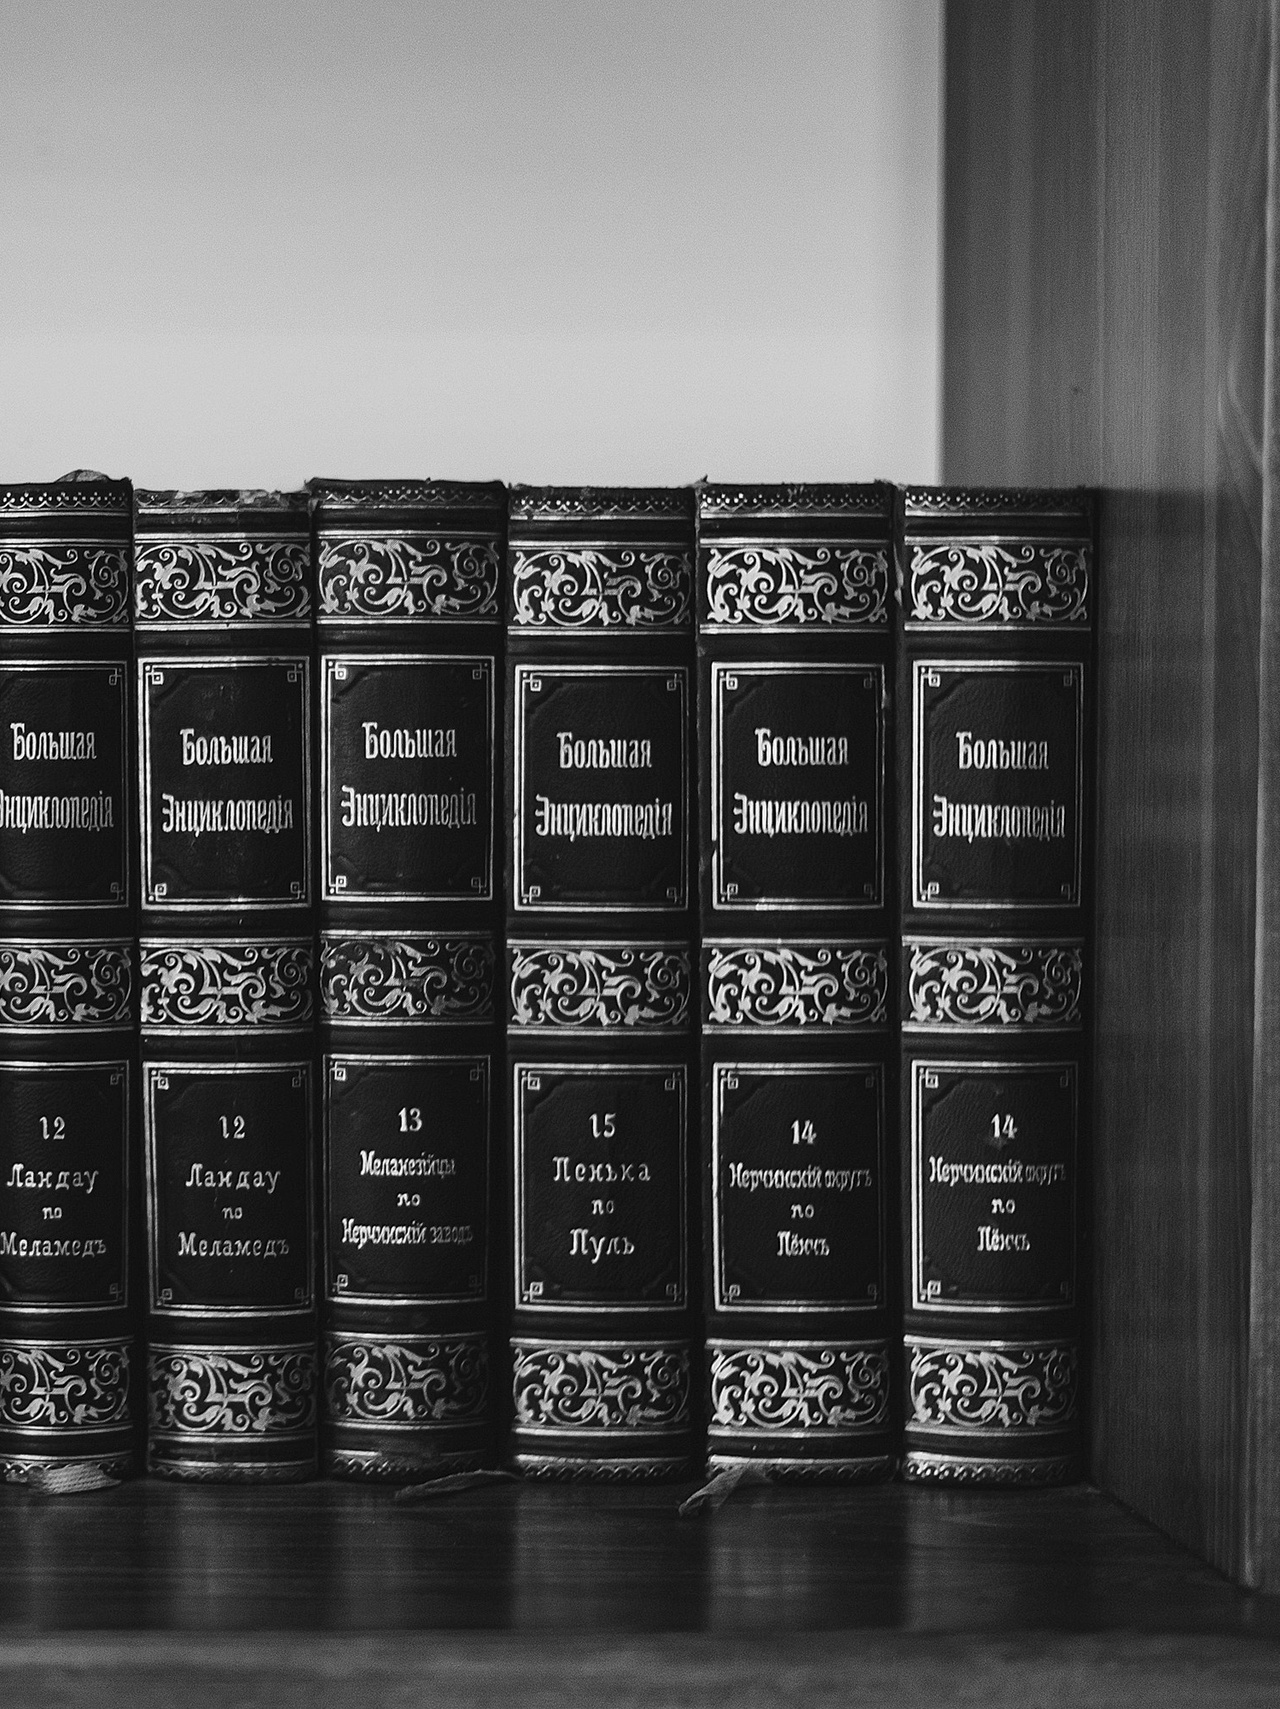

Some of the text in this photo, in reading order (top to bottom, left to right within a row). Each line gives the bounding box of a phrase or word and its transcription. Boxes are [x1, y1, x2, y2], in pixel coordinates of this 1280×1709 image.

[10, 723, 96, 760] Большая
[180, 728, 273, 765] Большая
[362, 722, 456, 759] Большая
[557, 732, 652, 768] Большая
[755, 728, 847, 766] Большая
[956, 732, 1048, 769] Большая
[162, 793, 292, 837] Энциклопедія
[341, 785, 477, 832] Энциклопедія
[535, 794, 672, 842] Энциклопедія
[733, 792, 867, 837] Энциклопедія
[933, 794, 1064, 843] Энциклопедія
[40, 1117, 65, 1139] 12
[220, 1116, 245, 1139] 12
[399, 1108, 422, 1132] 13
[590, 1114, 615, 1138] 15
[792, 1120, 816, 1144] 14
[992, 1114, 1017, 1138] 14
[7, 1163, 98, 1193] Ландау
[186, 1163, 280, 1193] Ландау
[553, 1157, 650, 1182] Пенька
[397, 1193, 420, 1206] по
[592, 1200, 613, 1214] по
[791, 1204, 814, 1218] по
[992, 1199, 1015, 1213] по
[42, 1207, 62, 1219] по
[222, 1207, 242, 1219] по
[0, 1232, 105, 1257] Меламедъ
[178, 1232, 288, 1258] Меламедъ
[570, 1229, 634, 1264] Пуль
